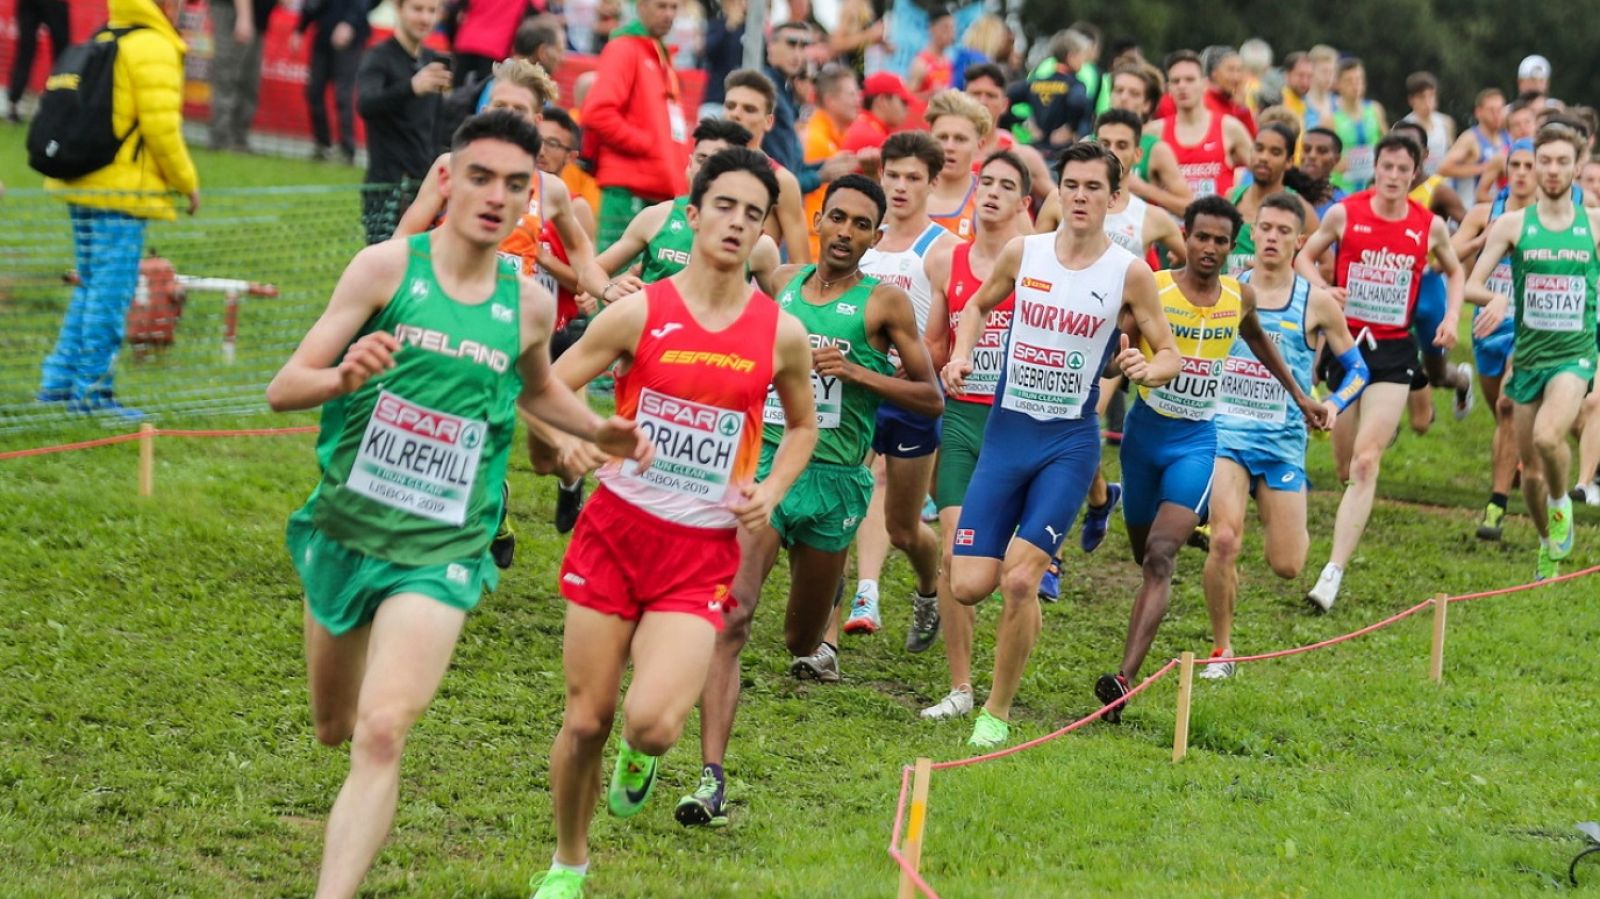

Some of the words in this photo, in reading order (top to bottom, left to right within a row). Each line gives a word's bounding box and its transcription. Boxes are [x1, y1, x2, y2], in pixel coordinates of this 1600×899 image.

[1523, 249, 1590, 262] IRELAND
[1526, 292, 1582, 310] McSTAY
[1020, 300, 1106, 339] NORWAY
[1170, 323, 1233, 341] SWEDEN
[394, 324, 511, 373] IRELAND
[1015, 344, 1064, 367] SPAR
[659, 349, 756, 373] ESPAÑA
[1008, 362, 1083, 395] INGEBRIGTSEN
[641, 392, 717, 432] SPAR
[1015, 400, 1045, 413] LISBOA
[1047, 403, 1068, 415] 2019
[1158, 402, 1188, 416] LISBOA
[375, 397, 459, 444] SPAR
[364, 426, 470, 487] KILREHILL
[640, 420, 733, 470] ORIACH
[673, 463, 707, 479] CLEAN
[368, 481, 415, 505] LISBOA
[416, 496, 446, 515] 2019
[682, 480, 710, 495] 2019
